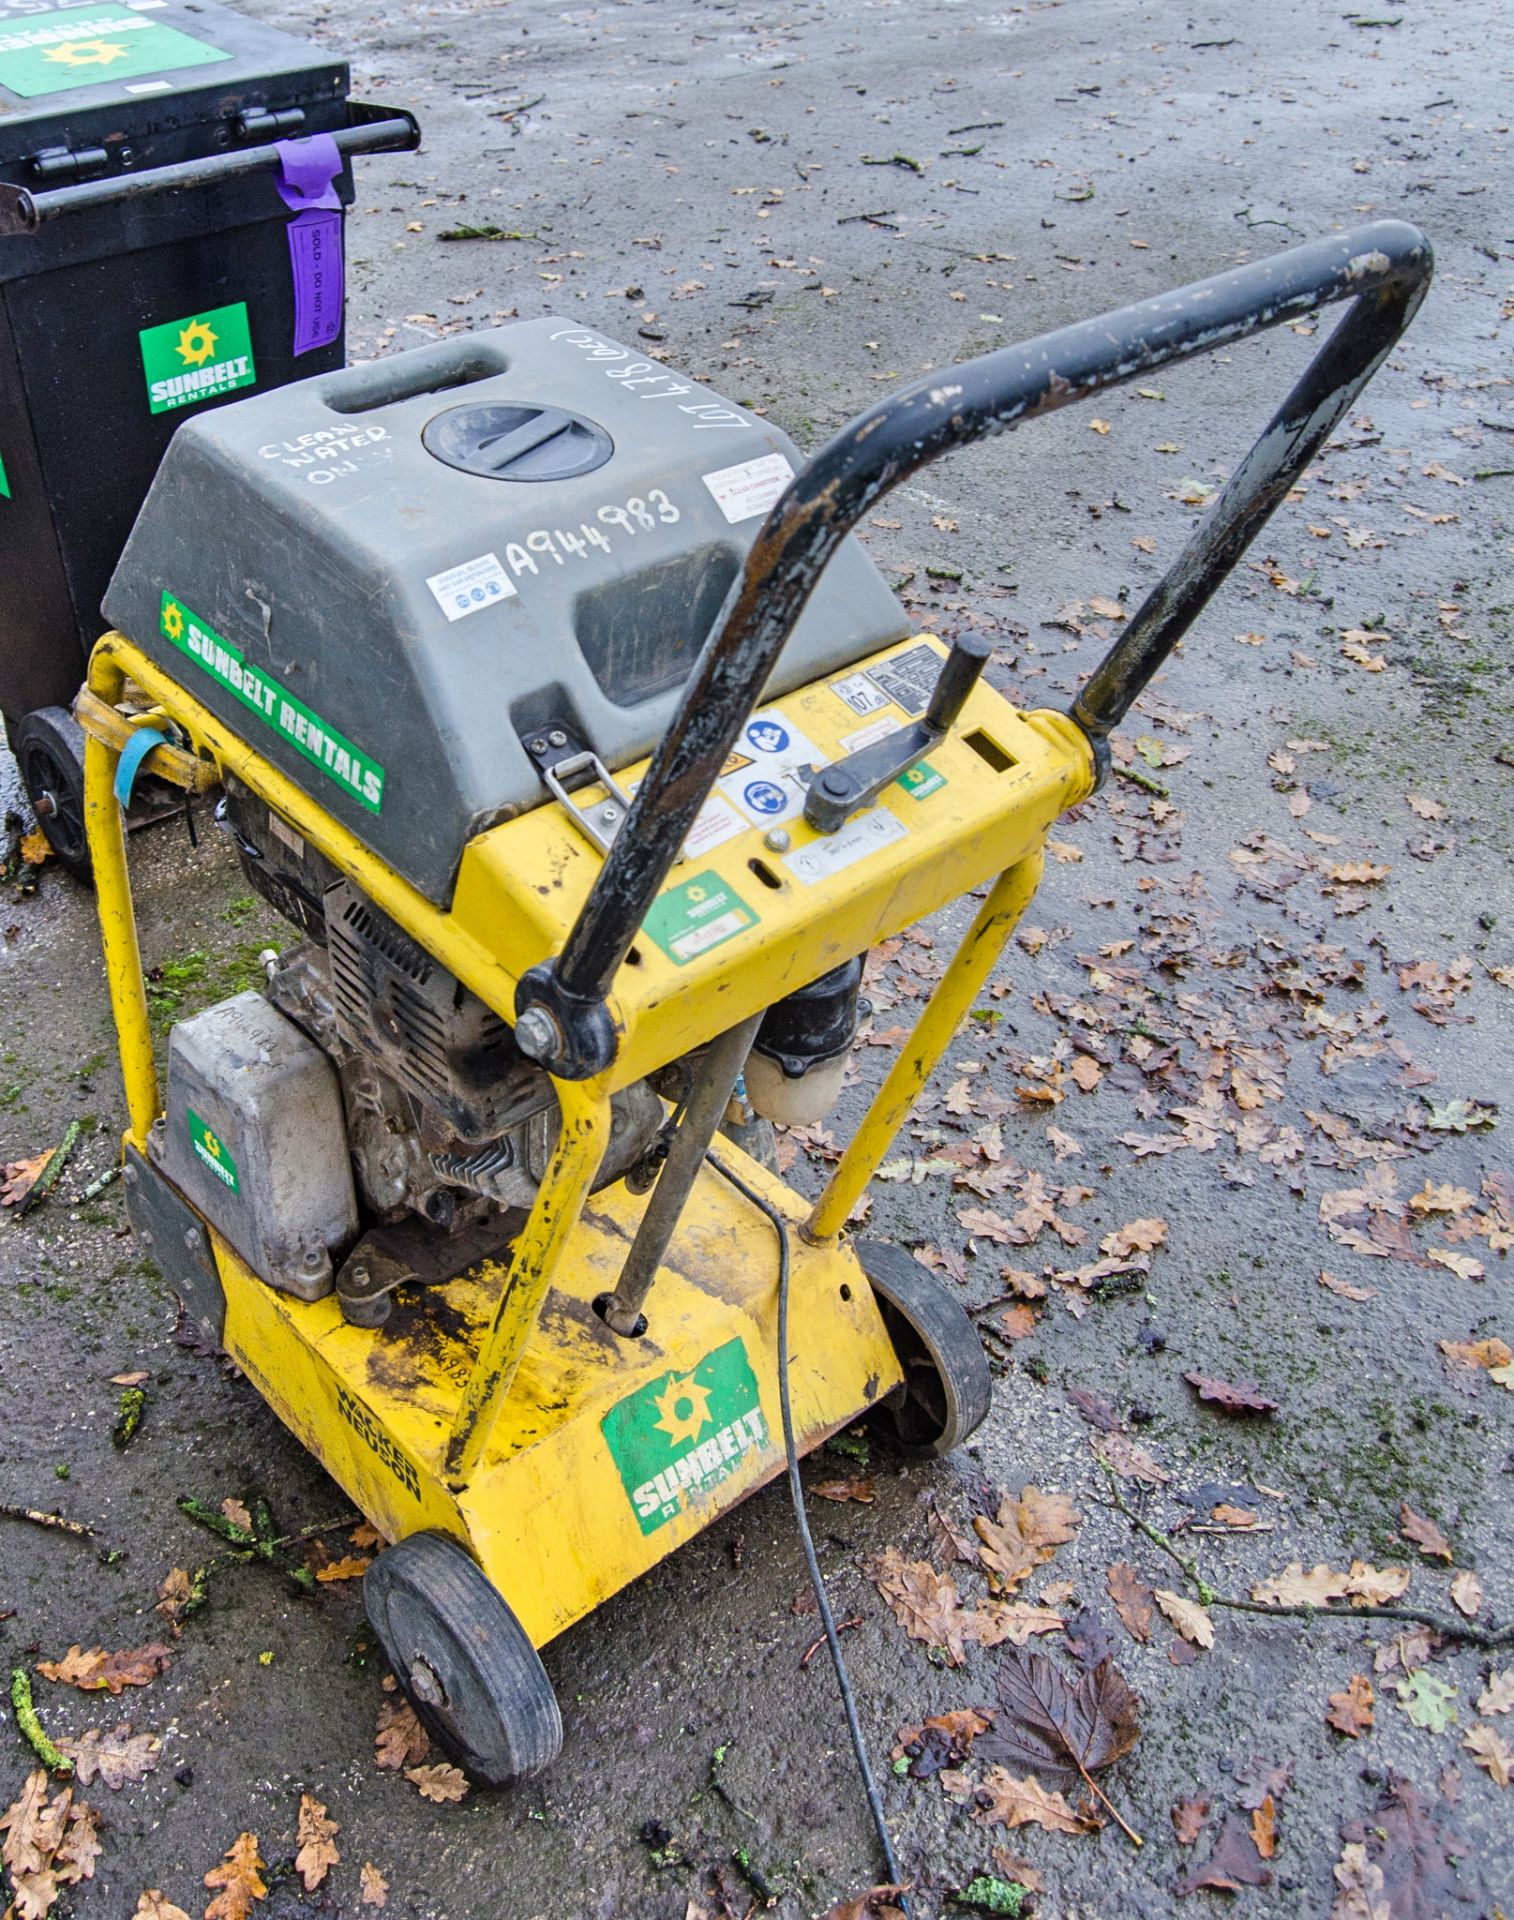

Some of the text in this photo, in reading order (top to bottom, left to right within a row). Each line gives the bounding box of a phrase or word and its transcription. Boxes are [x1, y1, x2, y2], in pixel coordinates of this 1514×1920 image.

[311, 228, 322, 261] SOLD
[314, 271, 322, 288] DO
[314, 291, 322, 313] NOT
[151, 355, 248, 403] SUNBELT
[166, 379, 237, 407] RENTALS
[605, 362, 693, 399] 478
[677, 403, 753, 429] LOT
[257, 422, 359, 459] CLEAN
[281, 426, 392, 467] WATER
[505, 488, 681, 577] A944983
[187, 623, 383, 805] SUNBELT RENTALS
[332, 1380, 421, 1486] WACKER
[337, 1398, 422, 1504] NEUSON
[632, 1405, 766, 1518] SUNBELT
